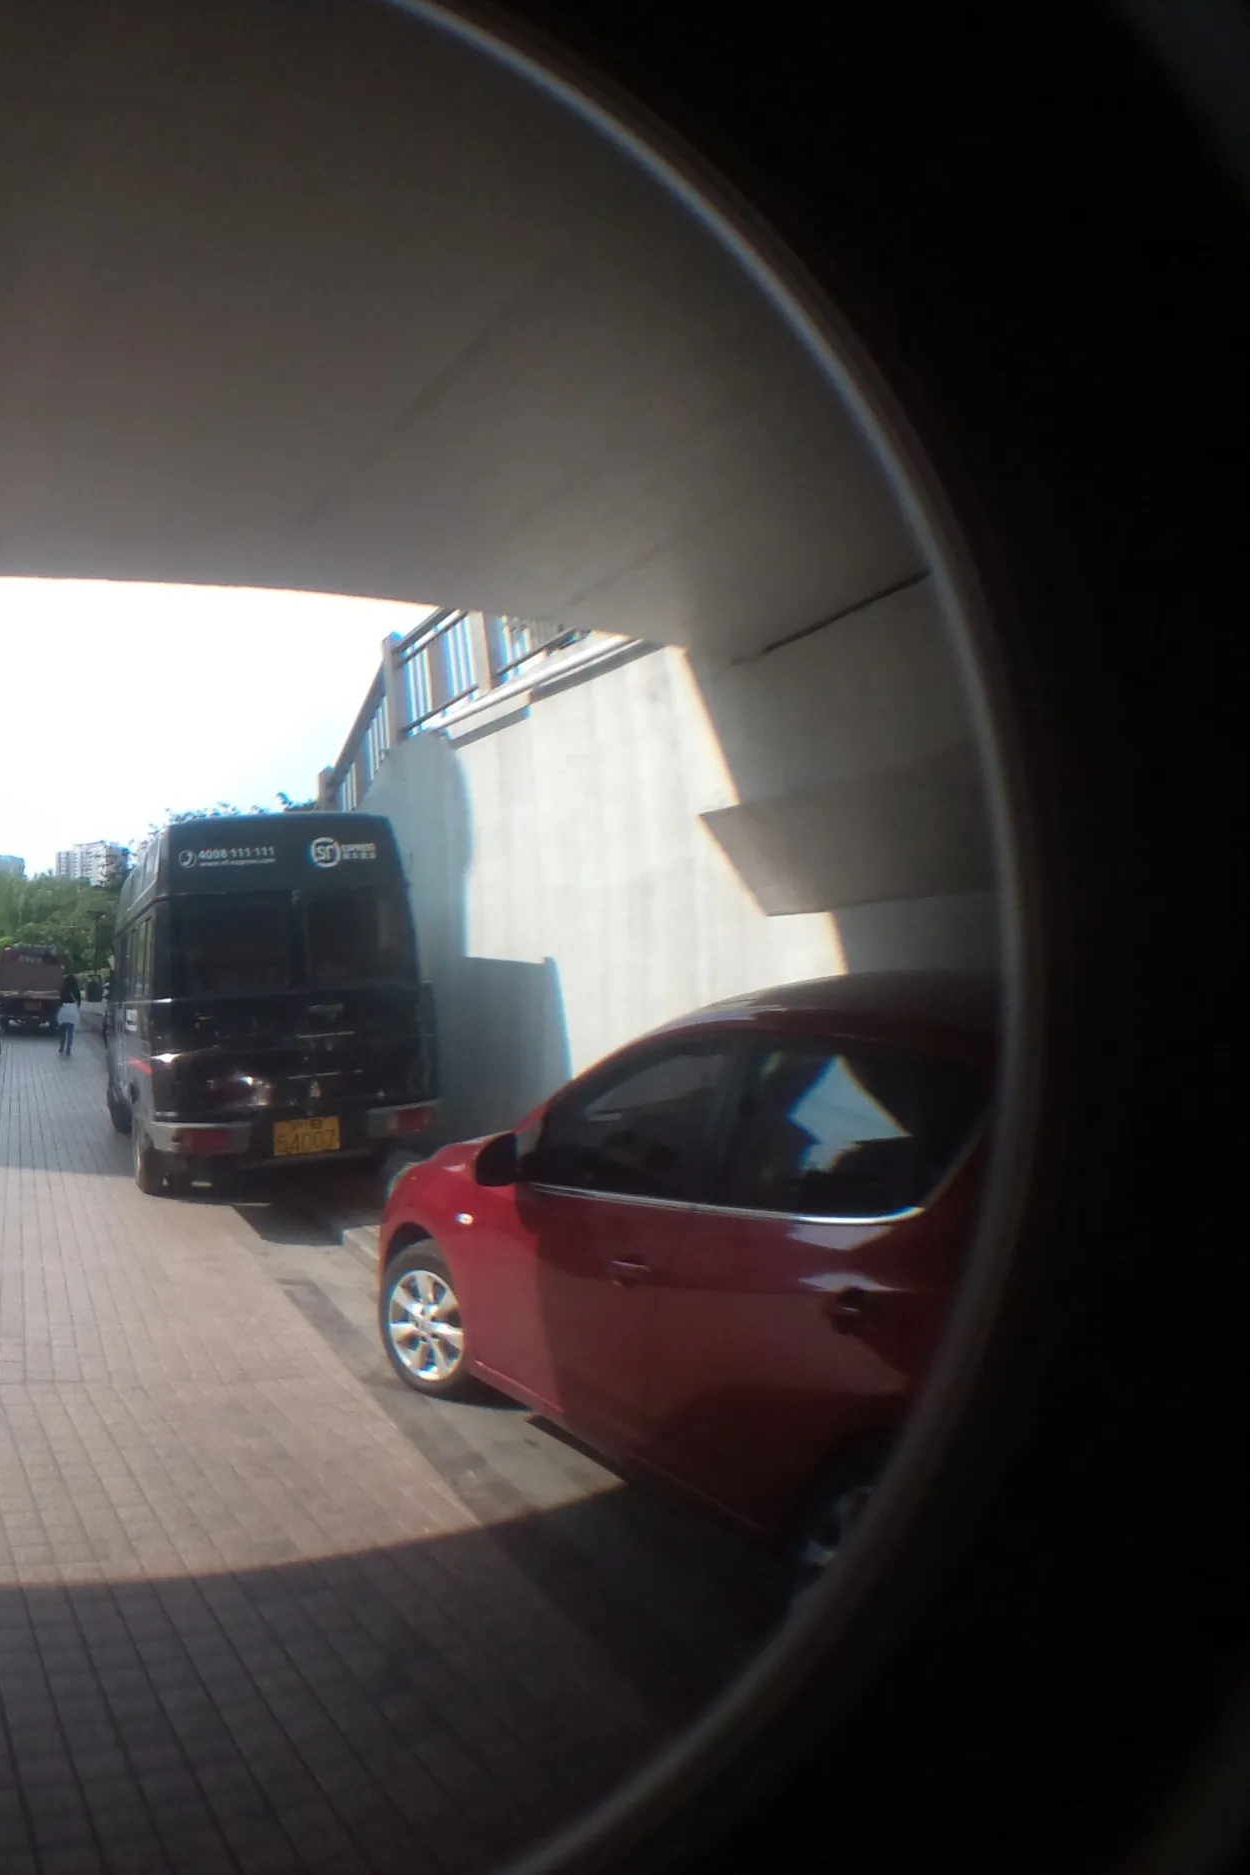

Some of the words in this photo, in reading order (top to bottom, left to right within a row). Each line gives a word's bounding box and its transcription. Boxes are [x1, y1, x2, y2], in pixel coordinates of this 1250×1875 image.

[197, 848, 228, 859] 4008
[230, 847, 252, 858] 111
[276, 1129, 336, 1153] 54007
